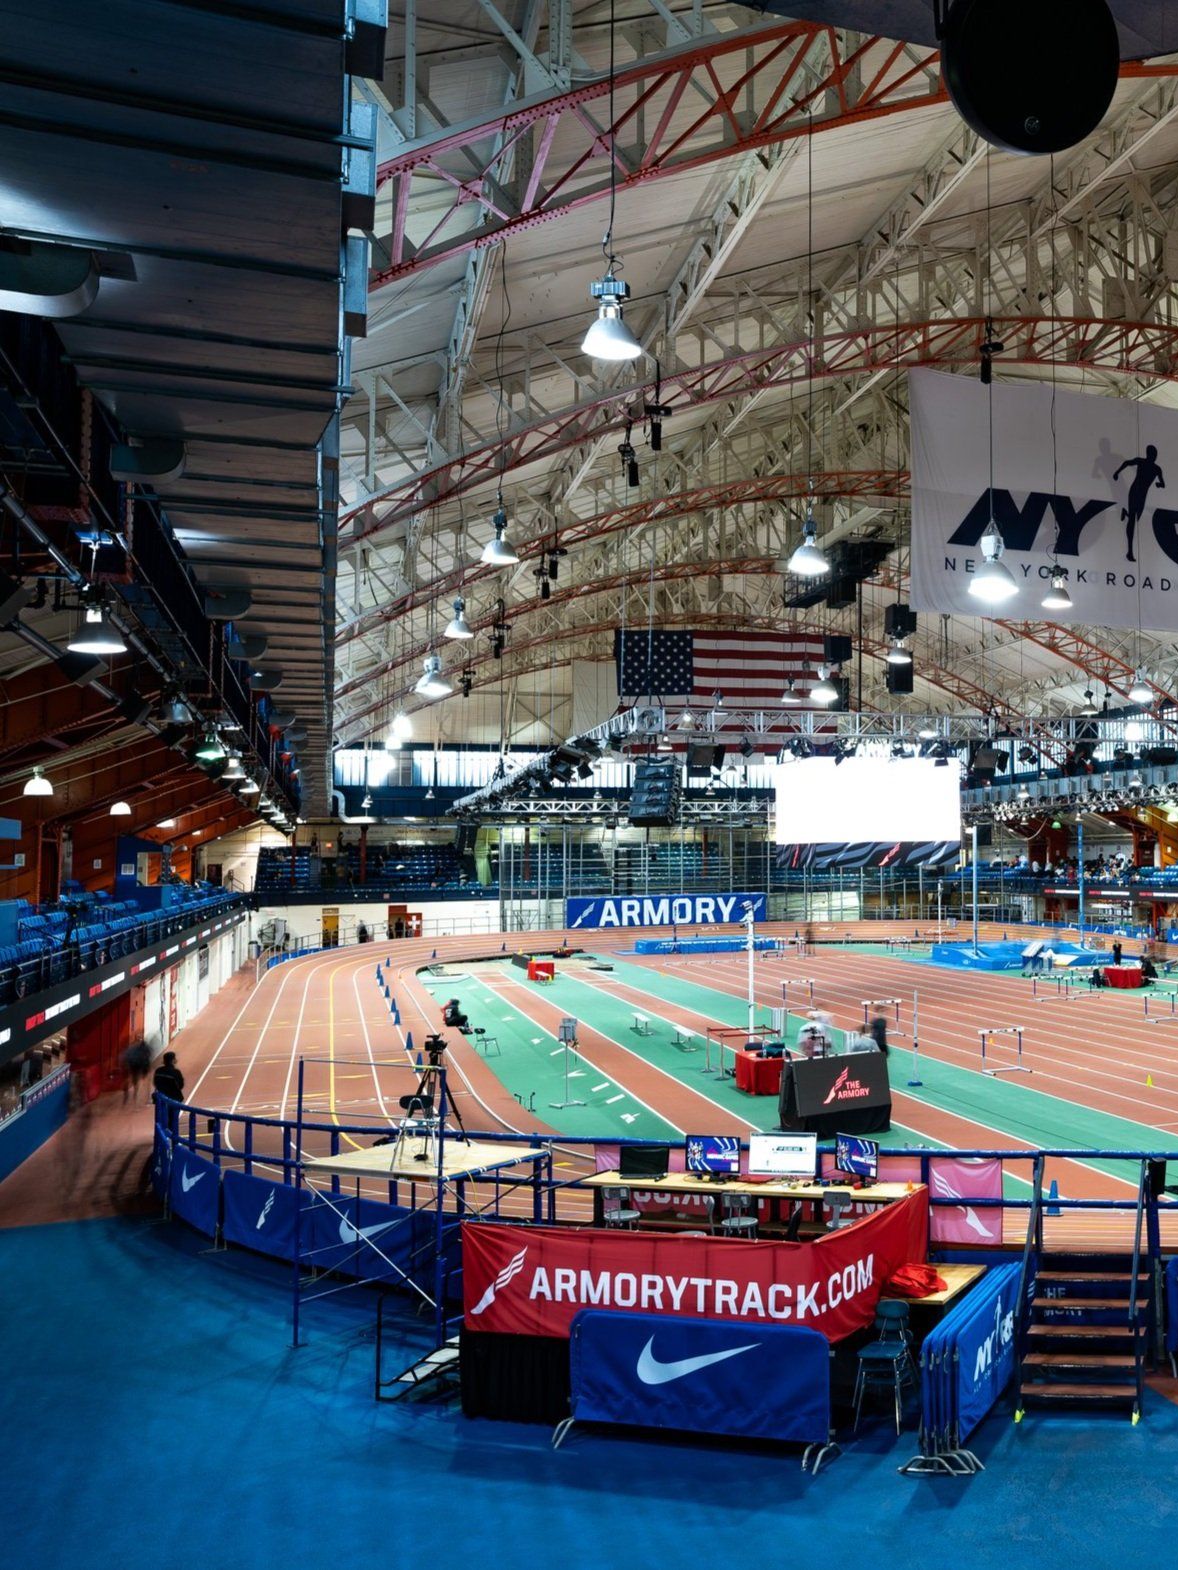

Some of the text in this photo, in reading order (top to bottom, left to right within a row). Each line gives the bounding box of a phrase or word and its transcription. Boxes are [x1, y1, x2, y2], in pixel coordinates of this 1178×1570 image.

[1107, 573, 1171, 592] ROAD
[599, 897, 737, 927] ARMORY
[838, 1088, 870, 1099] ARMORY
[845, 1080, 860, 1090] THE
[529, 1252, 875, 1320] ARMORYTRACK.COM
